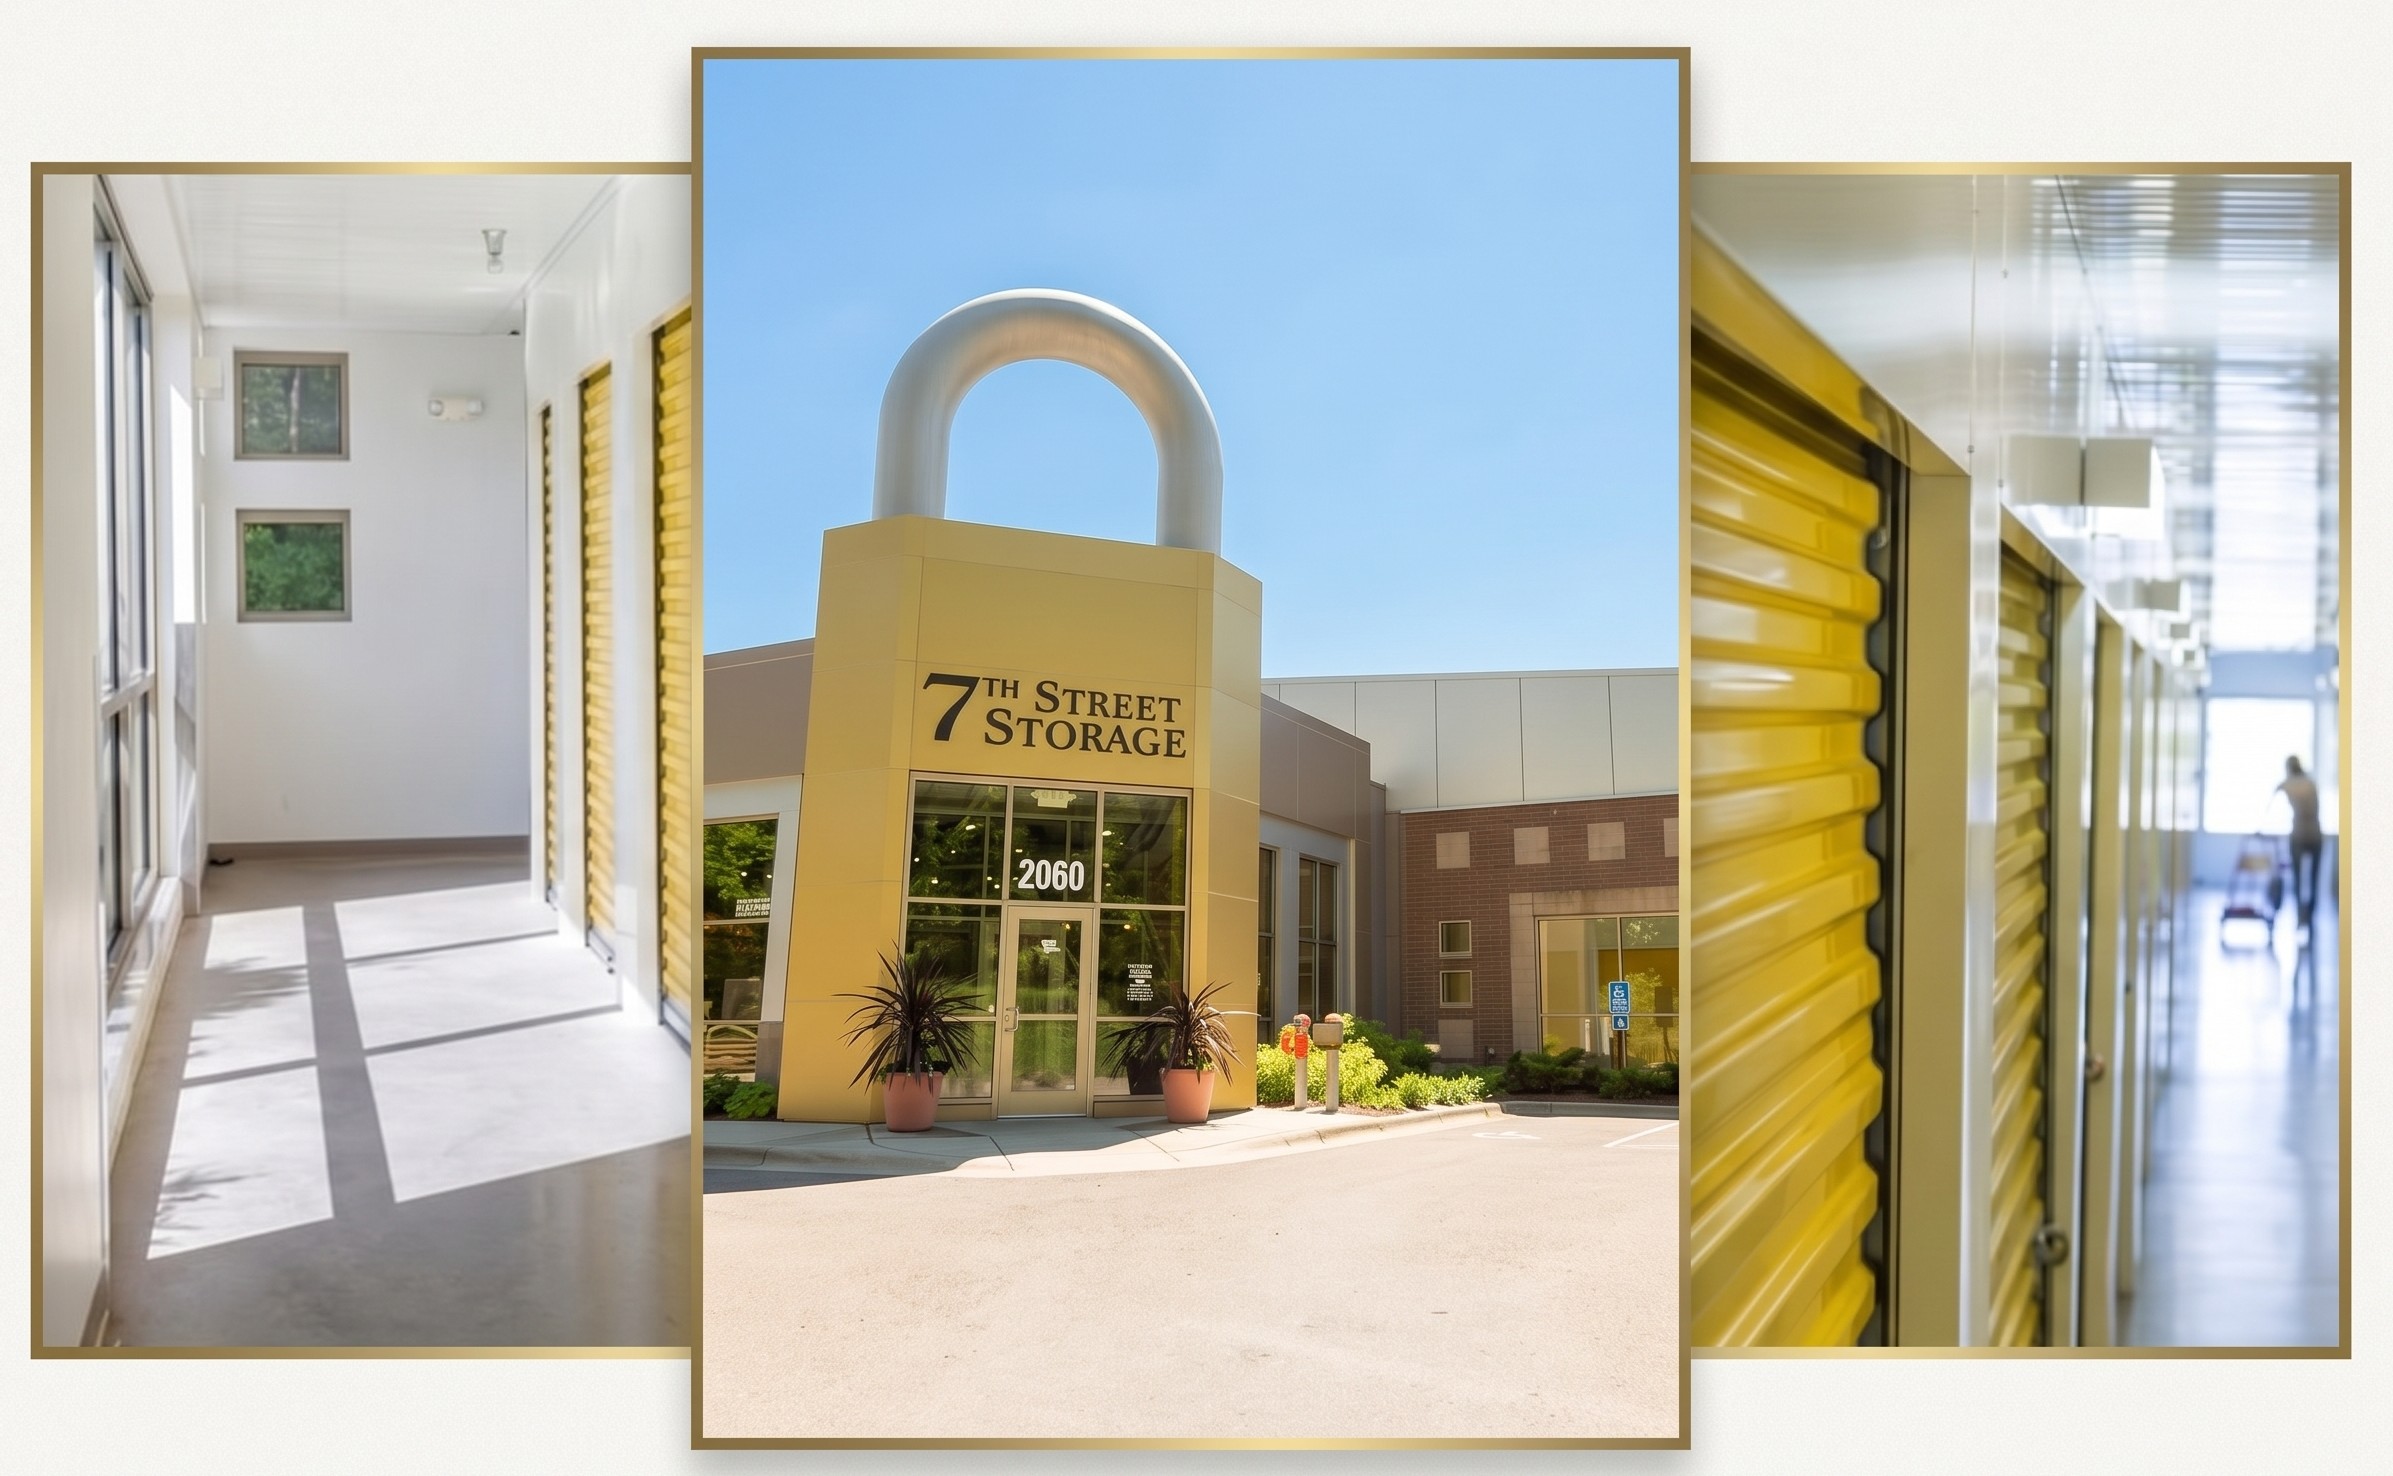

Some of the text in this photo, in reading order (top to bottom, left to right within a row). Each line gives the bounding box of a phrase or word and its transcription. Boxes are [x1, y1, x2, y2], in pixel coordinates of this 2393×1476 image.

[1034, 680, 1182, 723] STREET
[984, 707, 1187, 758] STORAGE
[1017, 858, 1085, 892] 2060
